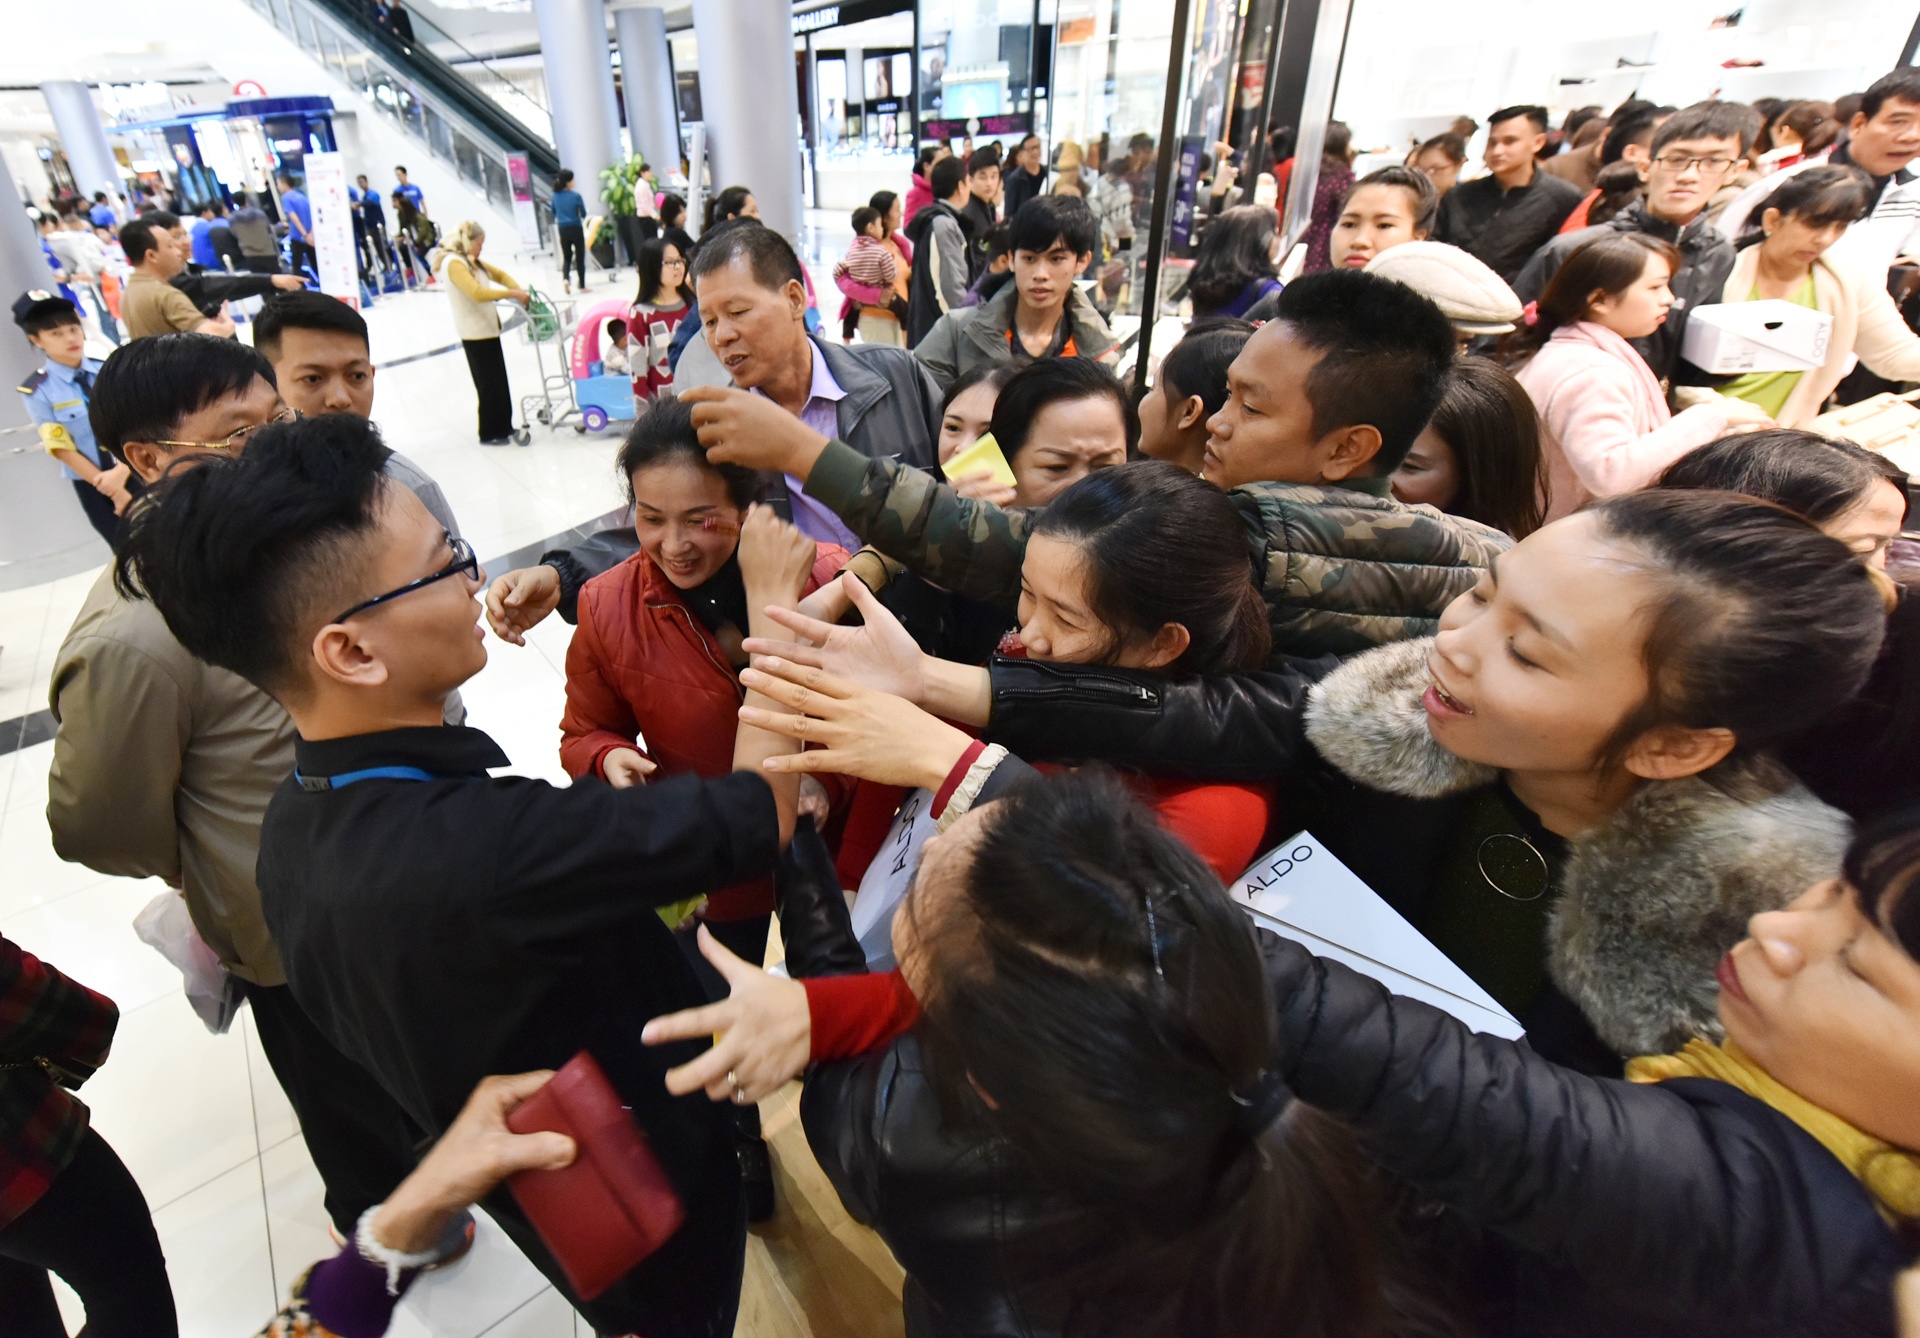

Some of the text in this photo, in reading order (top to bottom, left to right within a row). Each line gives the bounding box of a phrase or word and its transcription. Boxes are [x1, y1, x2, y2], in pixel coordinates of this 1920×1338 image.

[799, 6, 840, 32] GALLERY
[1812, 322, 1828, 357] ALDO
[890, 798, 920, 876] ALDO
[1246, 845, 1313, 900] ALDO
